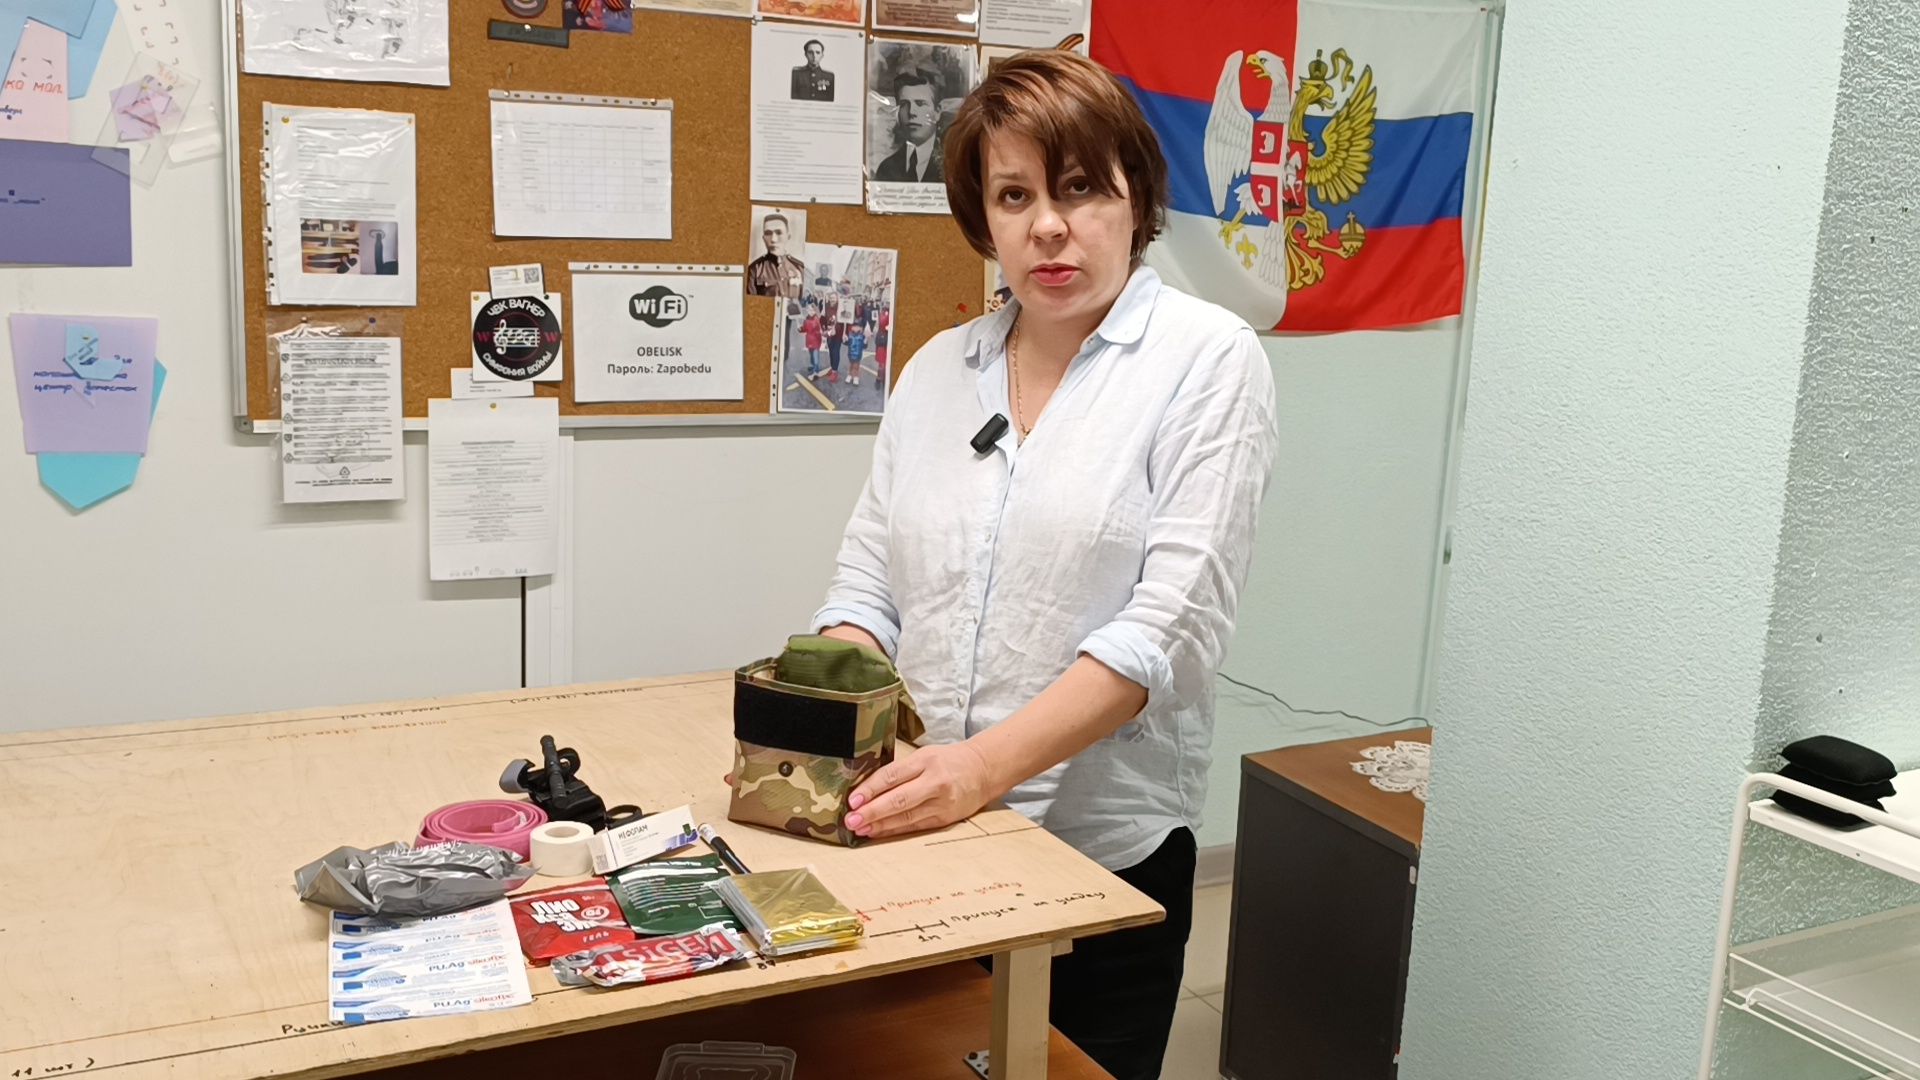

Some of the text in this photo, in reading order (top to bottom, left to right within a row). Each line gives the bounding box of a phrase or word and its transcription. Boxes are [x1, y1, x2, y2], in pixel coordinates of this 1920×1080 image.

[487, 299, 546, 317] ЧВК ВАГНЕР
[636, 346, 683, 357] OBELISK
[482, 351, 553, 376] СИМФОНИЯ ВОЙНЫ
[607, 363, 712, 376] Пароль: Zapobedu
[530, 899, 581, 915] ЛИО
[582, 931, 610, 944] ГЕЛЬ
